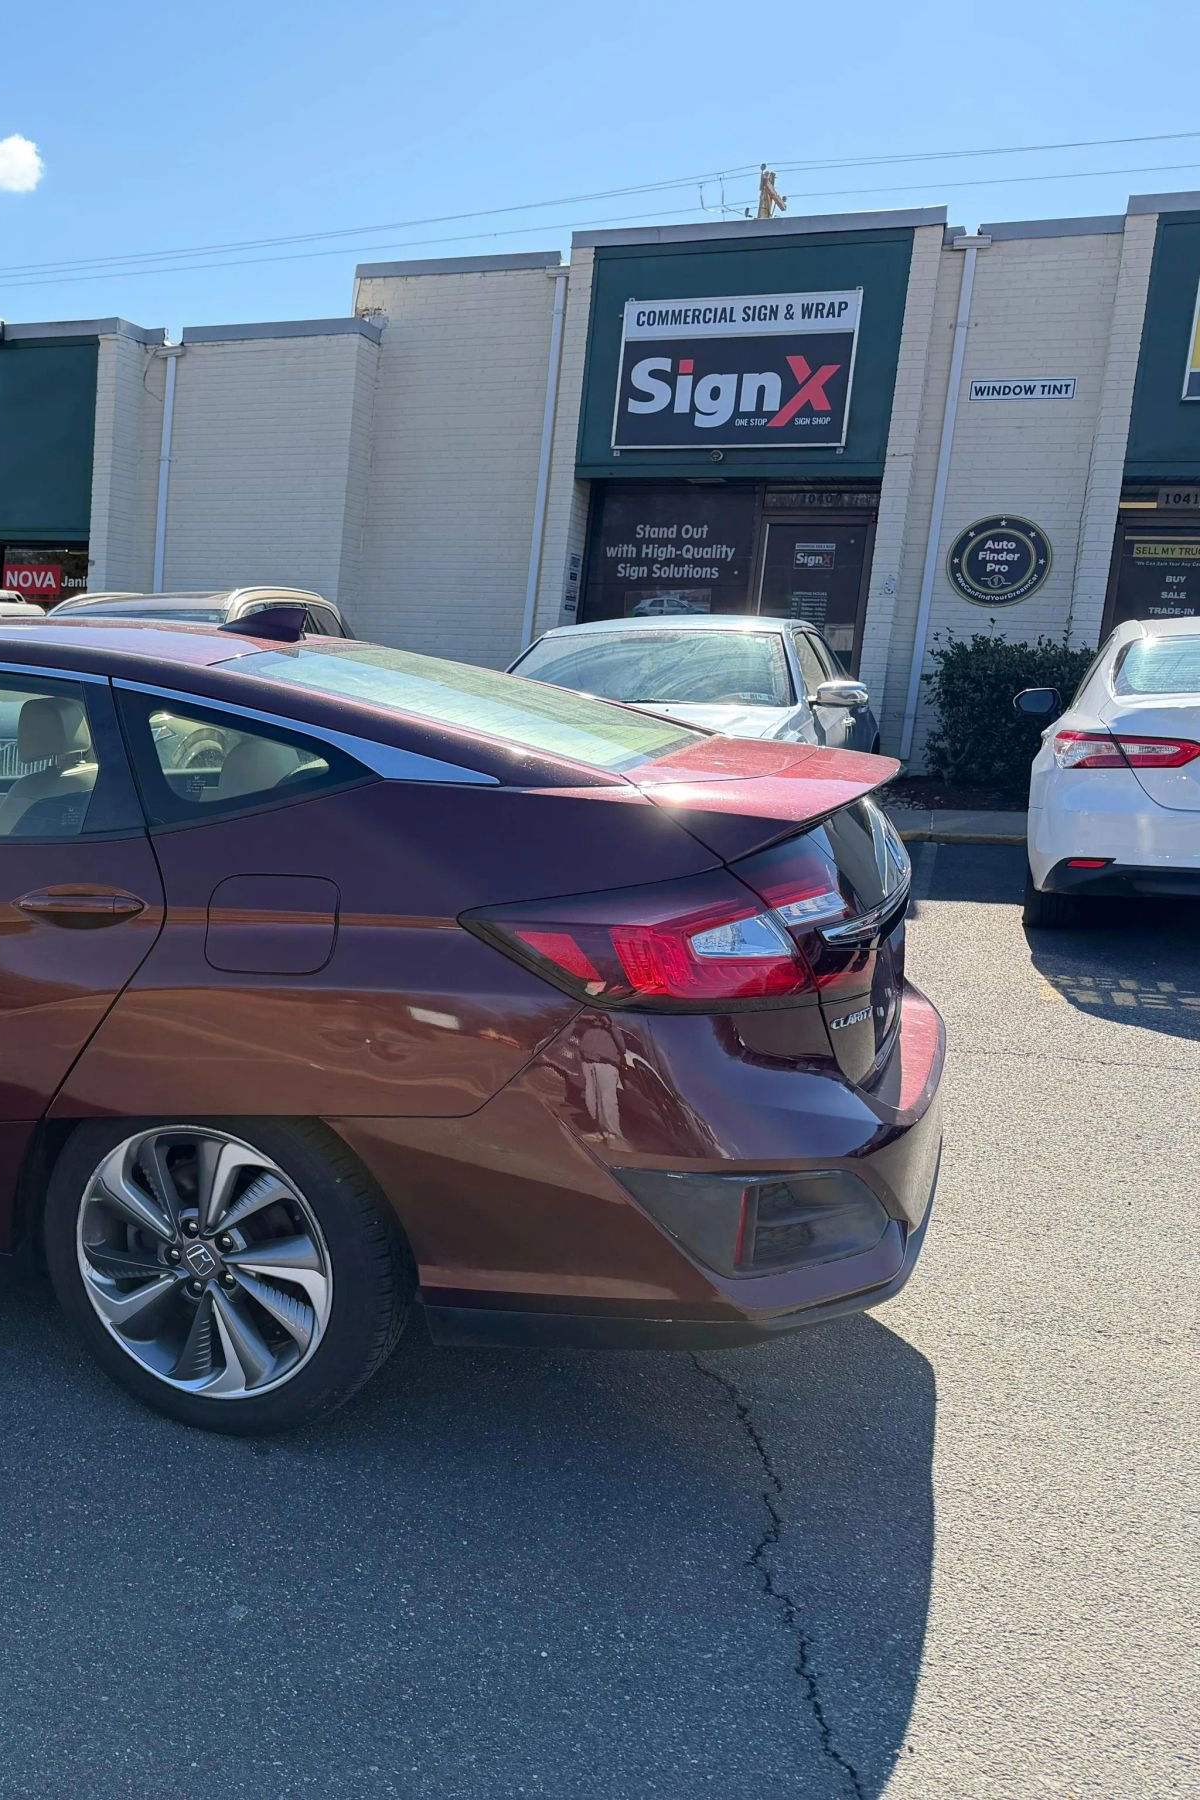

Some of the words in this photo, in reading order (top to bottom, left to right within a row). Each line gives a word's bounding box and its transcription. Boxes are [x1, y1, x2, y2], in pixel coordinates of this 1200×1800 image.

[636, 306, 737, 327] COMMERCIAL
[742, 304, 779, 323] SIGN
[783, 303, 795, 320] &
[801, 301, 849, 320] WRAP
[627, 355, 841, 428] SignX
[974, 384, 1037, 397] WINDOW
[1040, 384, 1072, 395] TINT
[735, 418, 749, 427] ONE
[750, 417, 768, 427] STOP
[794, 417, 811, 426] SIGN
[812, 416, 831, 425] SHOP
[635, 524, 677, 539] Stand
[681, 524, 709, 539] Out
[983, 540, 1016, 549] Auto
[606, 544, 637, 558] with
[641, 544, 736, 562] High-Quality
[978, 551, 1020, 561] Finder
[1135, 546, 1160, 555] SELL
[1161, 547, 1176, 556] MY
[795, 552, 832, 567] SignX
[617, 563, 648, 580] Sign
[651, 564, 719, 579] Solutions
[986, 563, 1009, 572] Pro
[6, 570, 57, 588] NOVA
[1165, 575, 1187, 583] BUY
[1160, 591, 1187, 599] SALE
[1148, 607, 1195, 615] TRADE-IN
